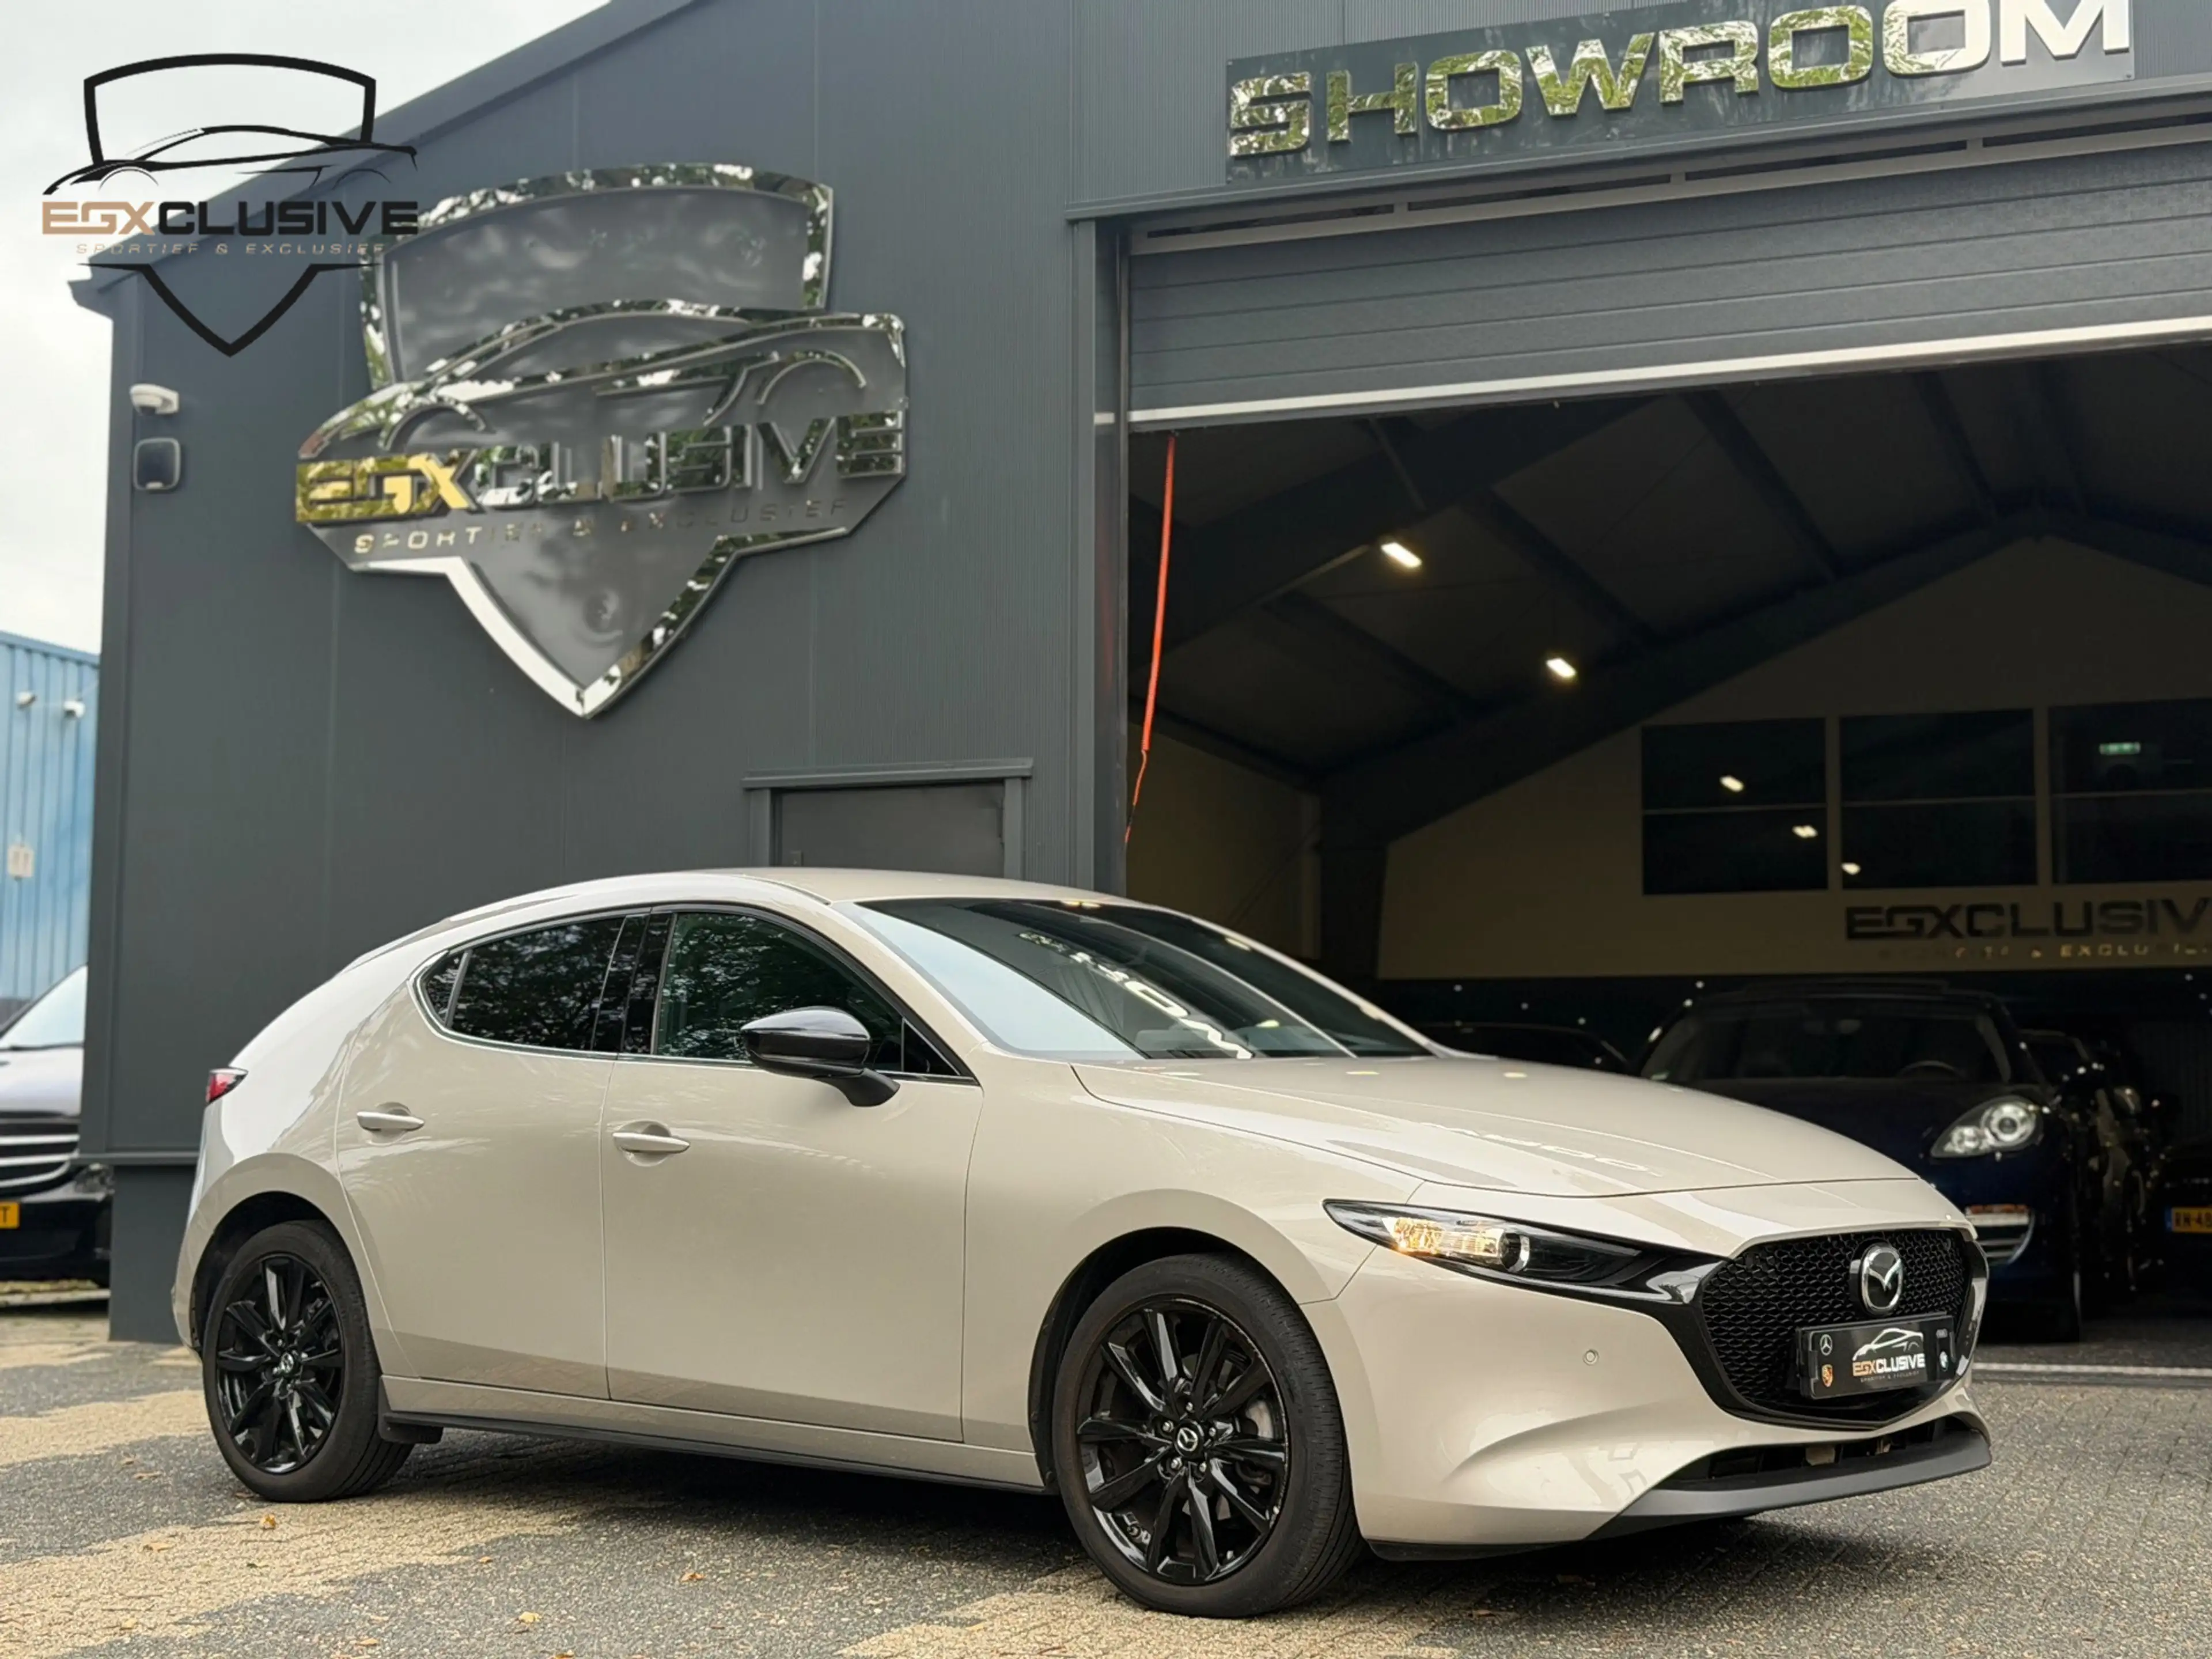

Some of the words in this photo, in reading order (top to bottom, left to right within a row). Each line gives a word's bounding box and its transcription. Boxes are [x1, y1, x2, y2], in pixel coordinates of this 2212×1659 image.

[1229, 0, 2130, 157] SHOWROOM
[296, 410, 903, 522] EGXCLUSIVE
[1852, 1353, 1926, 1377] EGXCLUSIVE
